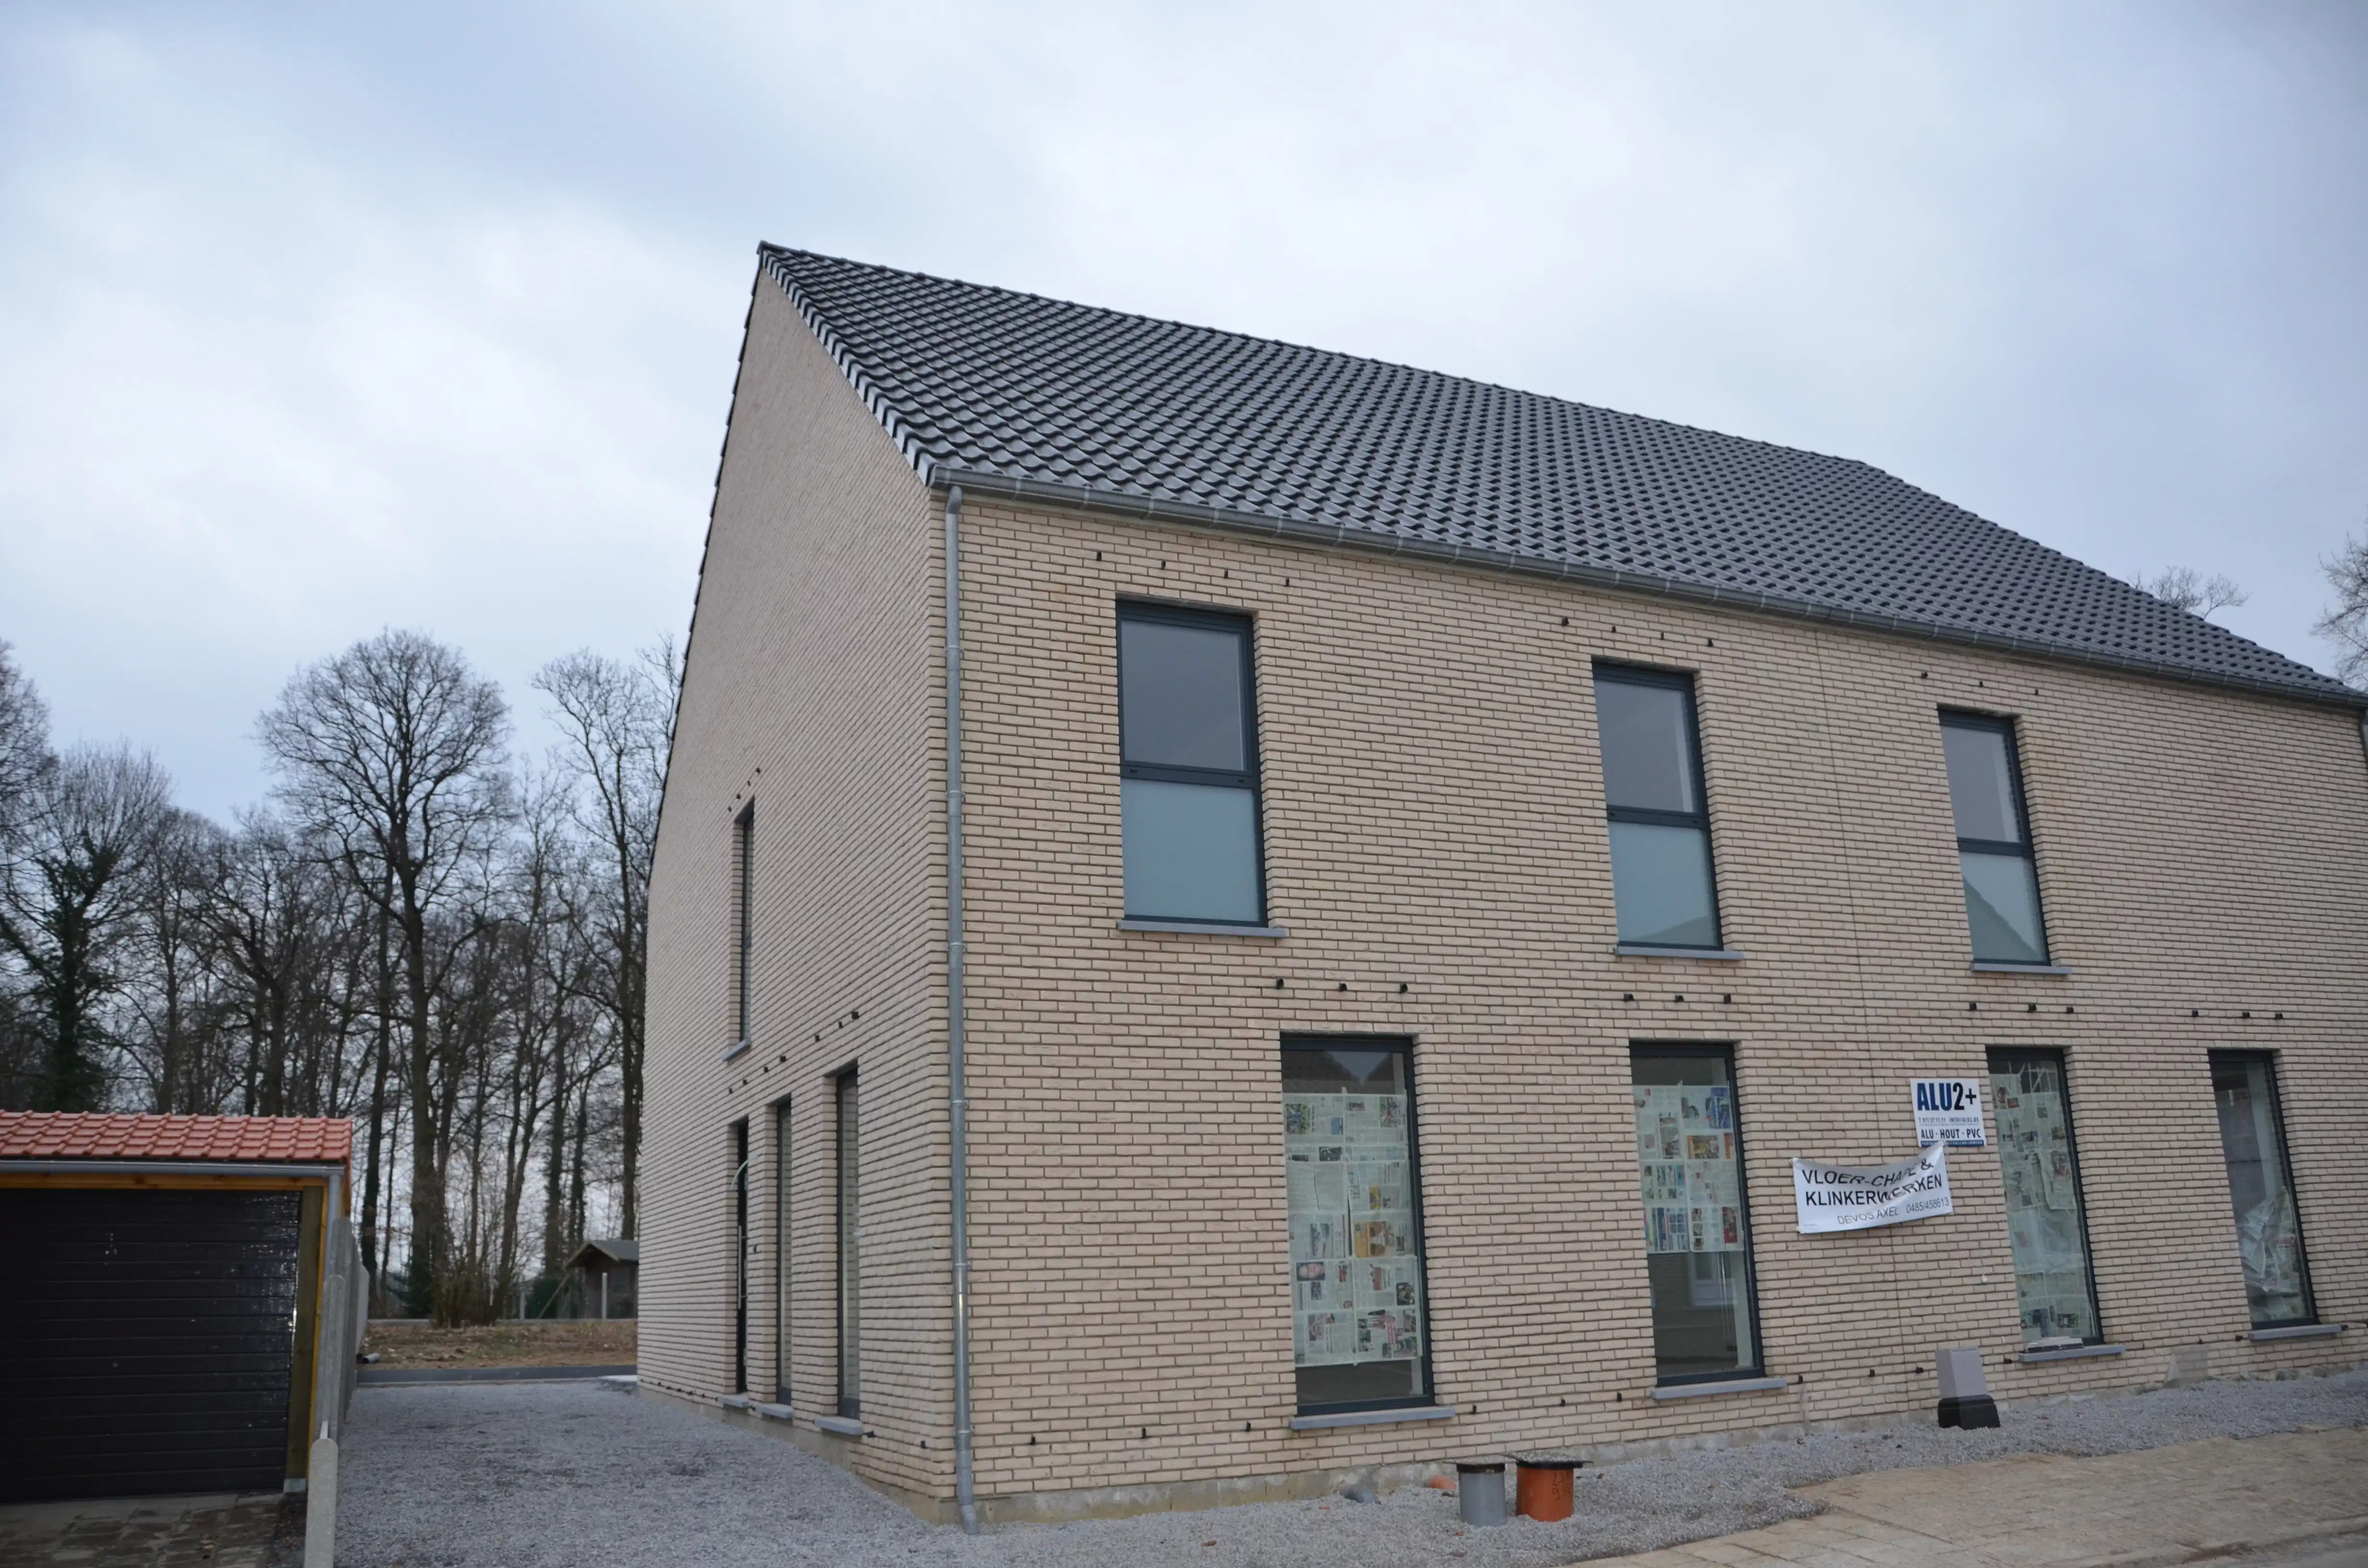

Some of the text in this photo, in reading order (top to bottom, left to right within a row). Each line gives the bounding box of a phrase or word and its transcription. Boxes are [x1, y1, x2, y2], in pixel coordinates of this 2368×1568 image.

[1917, 1082, 1976, 1111] ALU2+
[1921, 1128, 1982, 1139] ALU HOUT PVC
[1802, 1158, 1934, 1187] VLOER-CHAPE &
[1805, 1173, 1942, 1206] KLINKERWERKEN
[1837, 1212, 1875, 1225] DEVOS
[1876, 1206, 1899, 1219] AXEL
